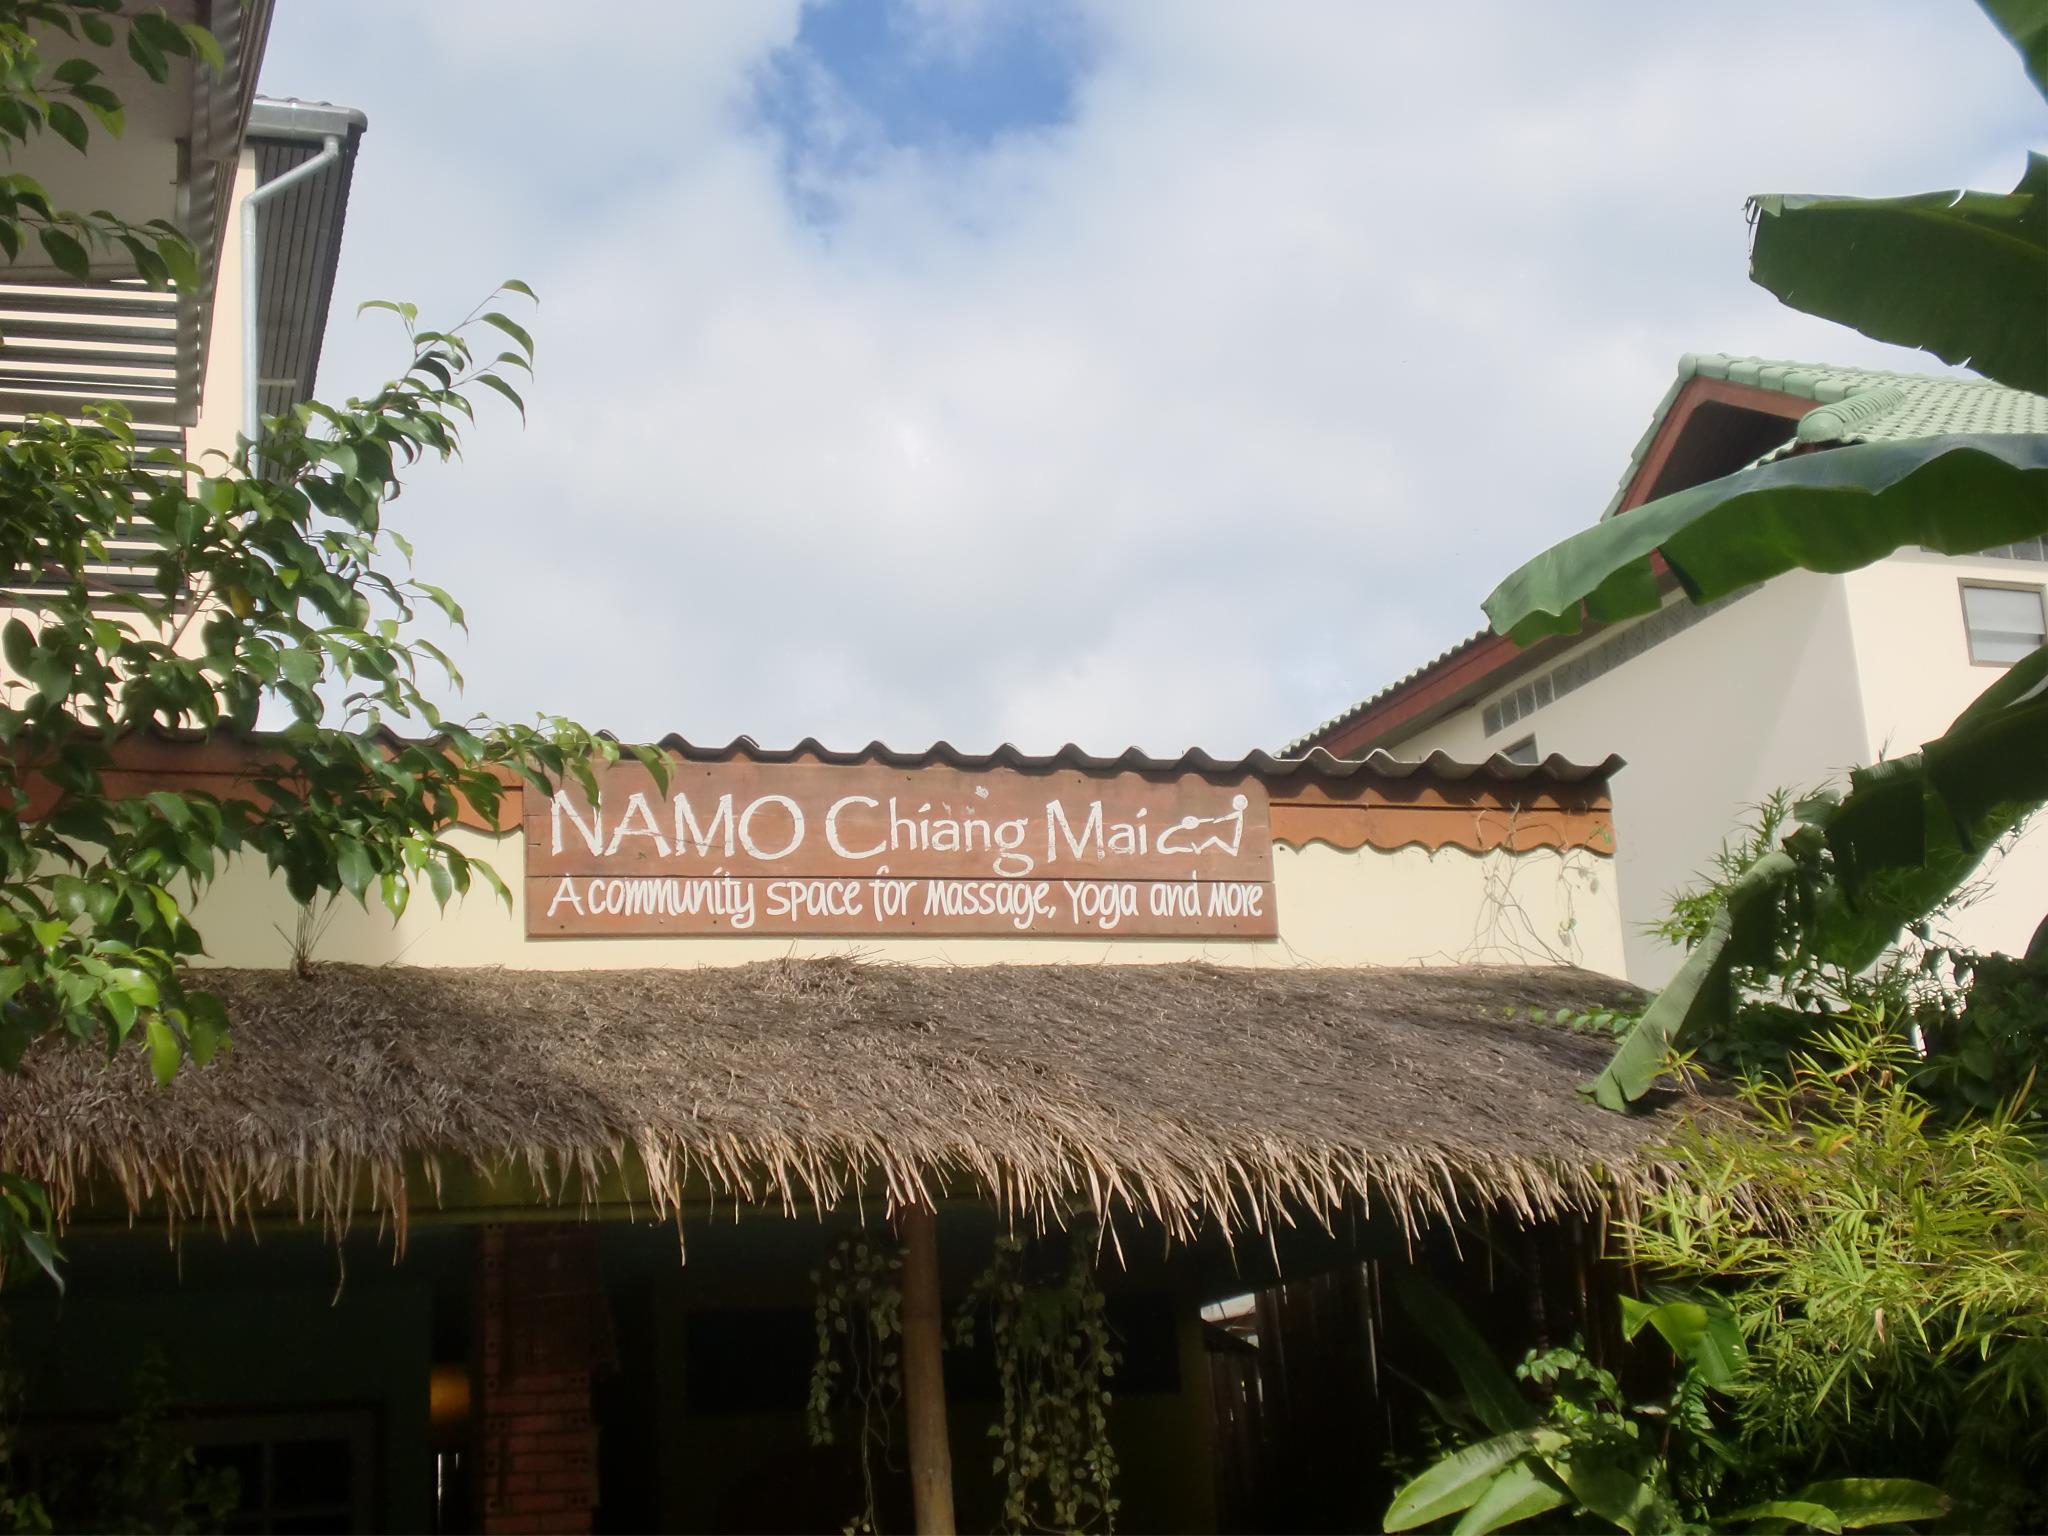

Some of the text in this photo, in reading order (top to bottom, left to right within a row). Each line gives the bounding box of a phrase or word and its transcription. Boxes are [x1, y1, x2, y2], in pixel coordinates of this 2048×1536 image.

[551, 790, 1148, 877] NAMO Chiang Mai
[547, 873, 585, 917] A
[587, 866, 754, 929] community
[766, 880, 863, 921] space
[869, 865, 917, 921] for
[1150, 870, 1202, 917] and
